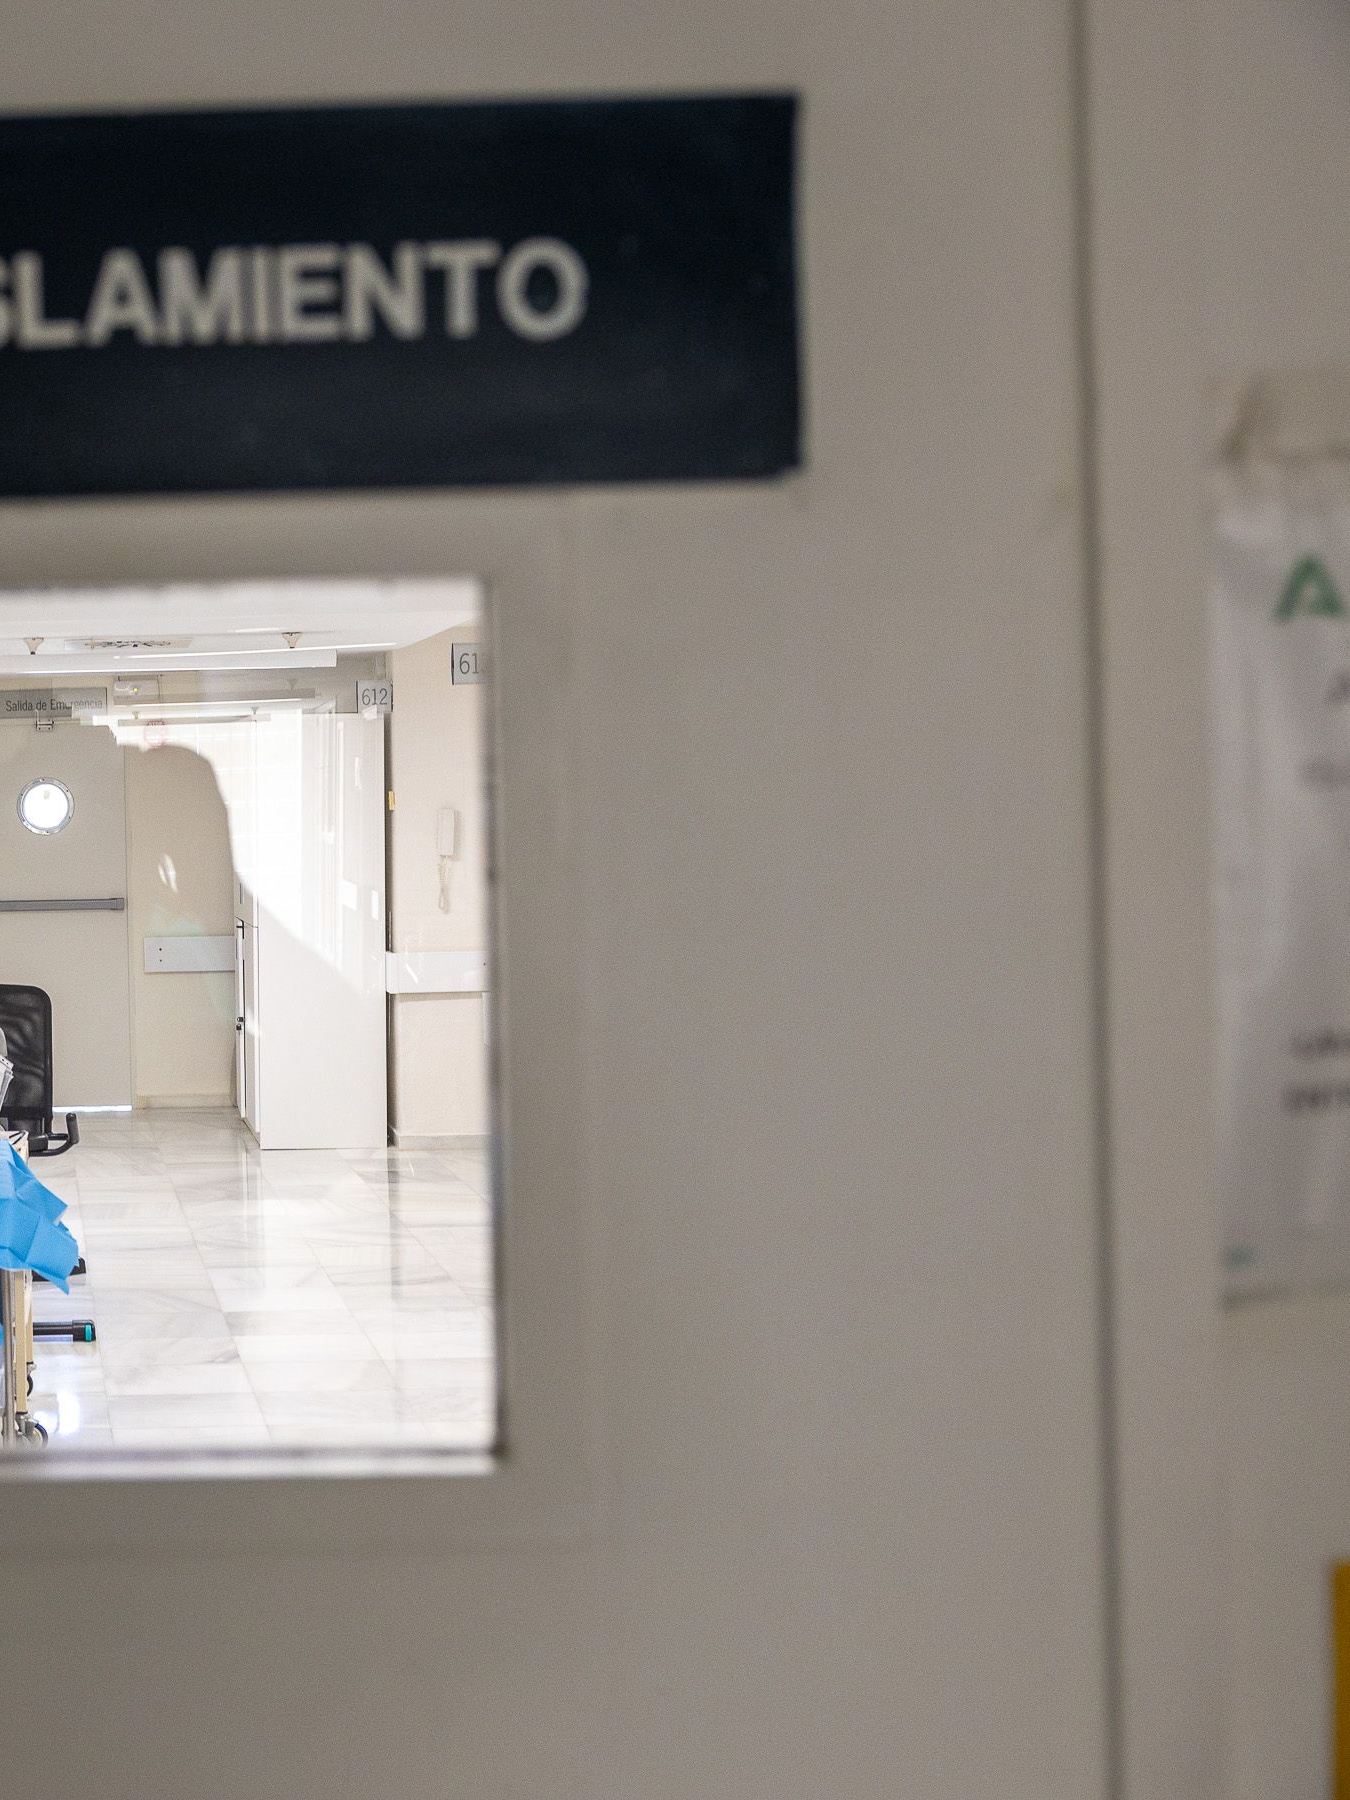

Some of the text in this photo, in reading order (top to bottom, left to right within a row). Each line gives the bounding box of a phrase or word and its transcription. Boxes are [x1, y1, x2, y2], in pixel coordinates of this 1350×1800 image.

[459, 652, 482, 675] 61
[5, 698, 103, 712] Salida de Emergencia
[361, 688, 388, 706] 612
